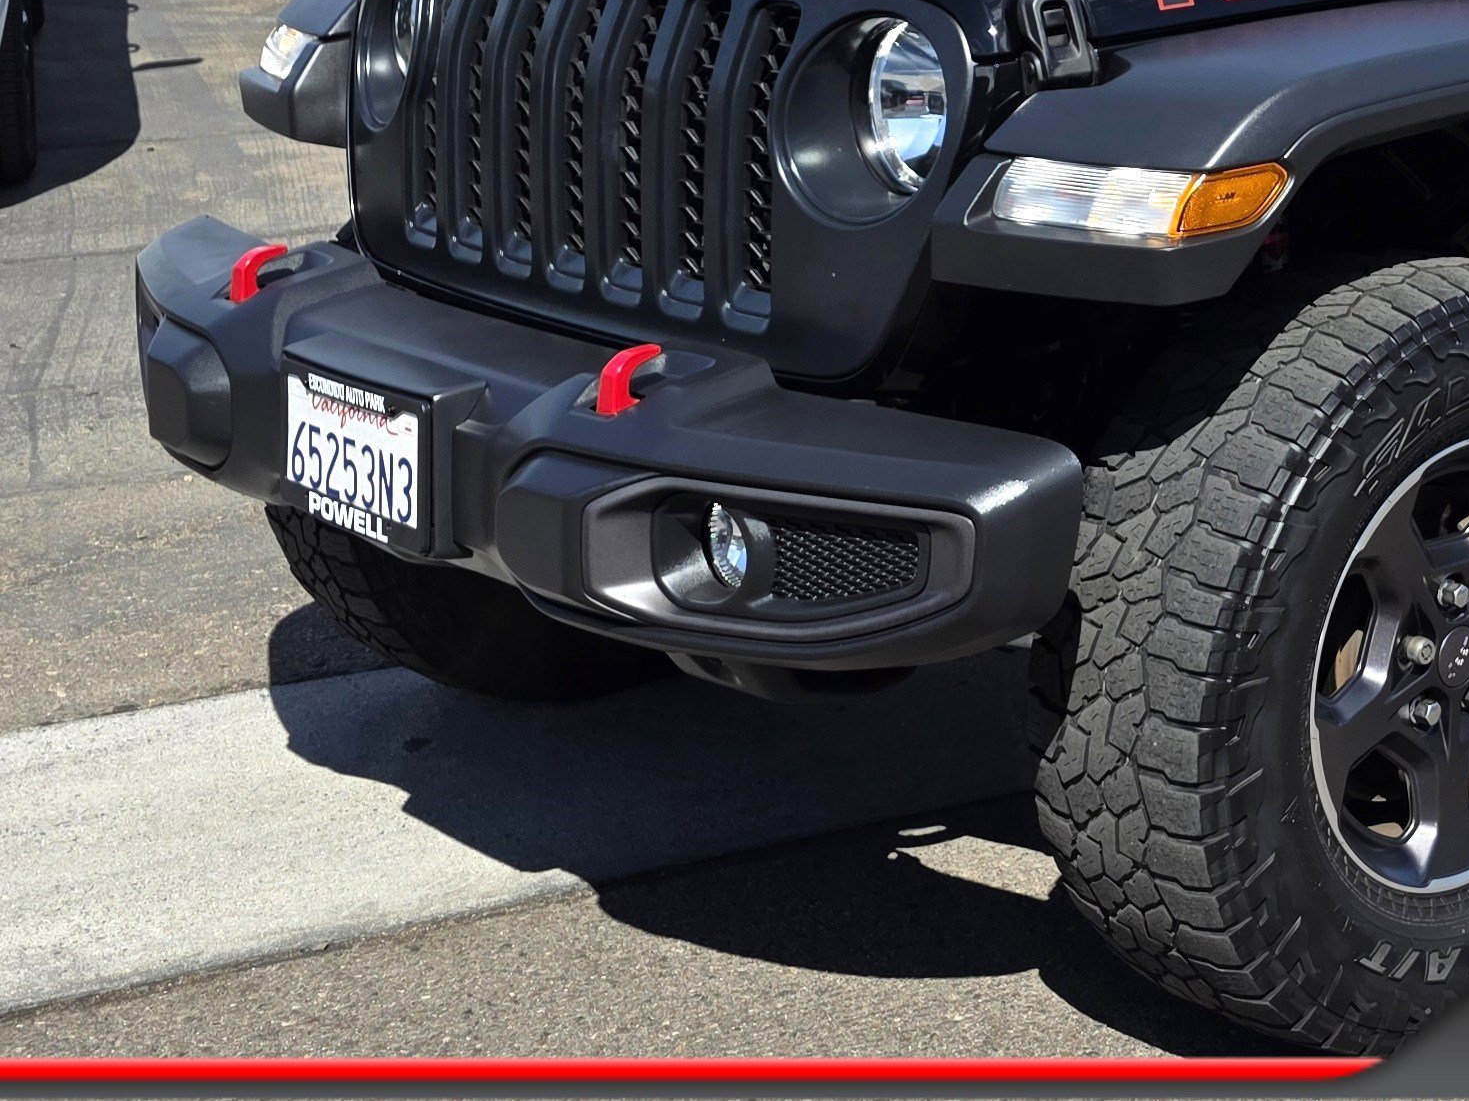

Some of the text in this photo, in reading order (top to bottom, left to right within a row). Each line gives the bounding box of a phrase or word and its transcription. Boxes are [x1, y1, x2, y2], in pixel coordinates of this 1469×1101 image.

[308, 373, 387, 415] ESCONDIDO AUTO PARK
[291, 421, 413, 523] 65253N3
[308, 491, 389, 544] POWELL
